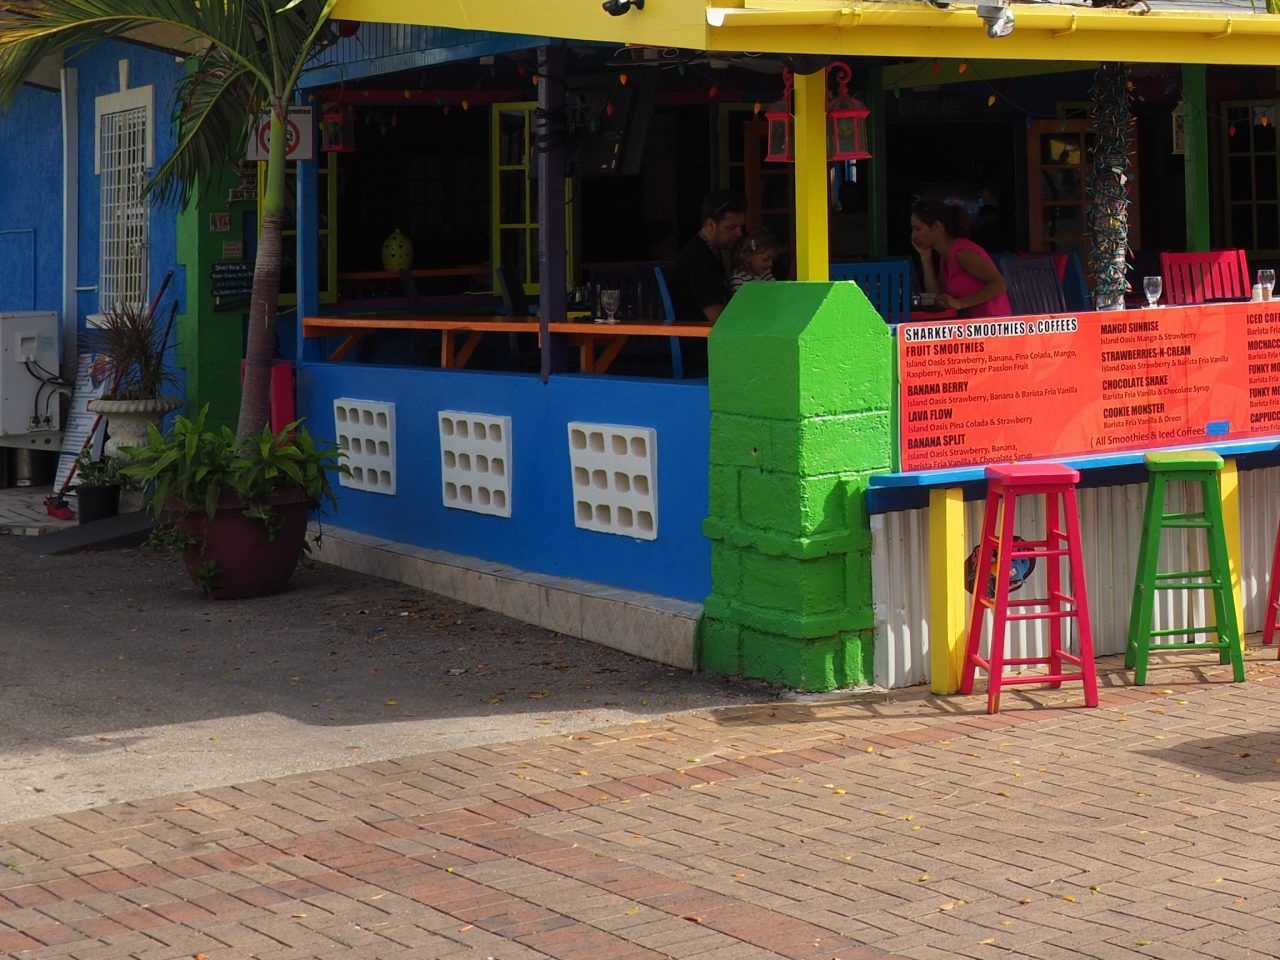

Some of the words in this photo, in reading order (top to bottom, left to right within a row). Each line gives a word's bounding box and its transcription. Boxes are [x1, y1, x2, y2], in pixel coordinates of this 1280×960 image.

[1246, 314, 1263, 325] ICED
[905, 325, 963, 341] SHARKEY'S
[966, 322, 1025, 338] SMOOTHIES
[1037, 319, 1077, 333] COFFEES
[1100, 323, 1127, 335] MANGO
[1129, 321, 1159, 333] SUNRISE
[1247, 327, 1268, 336] Barista
[1269, 326, 1280, 334] Fria
[1100, 337, 1118, 345] Island
[1137, 335, 1157, 343] Mango
[1164, 332, 1197, 340] Strawberry
[906, 344, 931, 357] FRUIT
[933, 341, 985, 355] SMOOTHIES
[1101, 345, 1191, 362] STRAWBERRIES-N-CREAM
[1248, 352, 1267, 360] Barista
[906, 359, 926, 368] Island
[928, 358, 945, 366] Oasis
[947, 356, 987, 365] Strawberry,
[988, 354, 1014, 362] Banana,
[1015, 352, 1028, 360] Pina
[1030, 351, 1052, 359] Colada,
[1054, 350, 1077, 358] Mango,
[1101, 364, 1119, 372] Island
[1120, 363, 1136, 371] Oasis
[1137, 360, 1170, 369] Strawberry
[1177, 358, 1197, 366] Barista
[1210, 354, 1229, 363] Vanilla
[907, 369, 943, 379] Raspberry,
[944, 366, 977, 376] Wildberry
[988, 364, 1012, 372] Passion
[1014, 362, 1028, 371] Fruit
[1248, 363, 1269, 375] FUNKY
[1102, 377, 1144, 390] CHOCOLATE
[1145, 374, 1168, 387] SHAKE
[1248, 376, 1267, 384] Barista
[907, 383, 940, 396] BANANA
[942, 381, 968, 393] BERRY
[908, 398, 927, 407] Island
[929, 397, 947, 406] Oasis
[948, 394, 989, 404] Strawberry,
[990, 393, 1013, 401] Banana
[1022, 389, 1043, 397] Barista
[1044, 388, 1056, 396] Fria
[1057, 385, 1078, 394] Vanilla
[1102, 392, 1123, 400] Barista
[1124, 391, 1136, 399] Fria
[1136, 389, 1156, 397] Vanilla
[1163, 386, 1192, 395] Chocolate
[1193, 385, 1210, 393] Syrup
[1249, 387, 1270, 398] FUNKY
[1103, 406, 1130, 419] COOKIE
[1131, 402, 1165, 416] MONSTER
[1249, 400, 1268, 408] Barista
[908, 410, 928, 422] LAVA
[930, 408, 952, 420] FLOW
[1103, 421, 1124, 429] Barista
[1125, 419, 1136, 427] Fria
[1137, 417, 1157, 425] Vanilla
[1164, 415, 1182, 423] Oreos
[908, 424, 928, 433] Island
[929, 423, 948, 431] Oasis
[949, 421, 964, 429] Pina
[965, 419, 988, 428] Colada
[997, 416, 1032, 425] Strawberry
[1250, 425, 1269, 433] Barista
[907, 436, 941, 449] BANANA
[943, 433, 966, 446] SPLIT
[1095, 435, 1106, 446] All
[1107, 432, 1149, 445] Smoothies
[1158, 428, 1175, 439] Iced
[1176, 426, 1205, 437] Coffees
[908, 451, 928, 460] Island
[929, 450, 948, 458] Oasis
[949, 446, 990, 455] Strawberry,
[991, 443, 1018, 452] Banana,
[908, 461, 931, 470] Barista
[947, 457, 970, 466] Vanilla
[979, 453, 1013, 463] Chocolate
